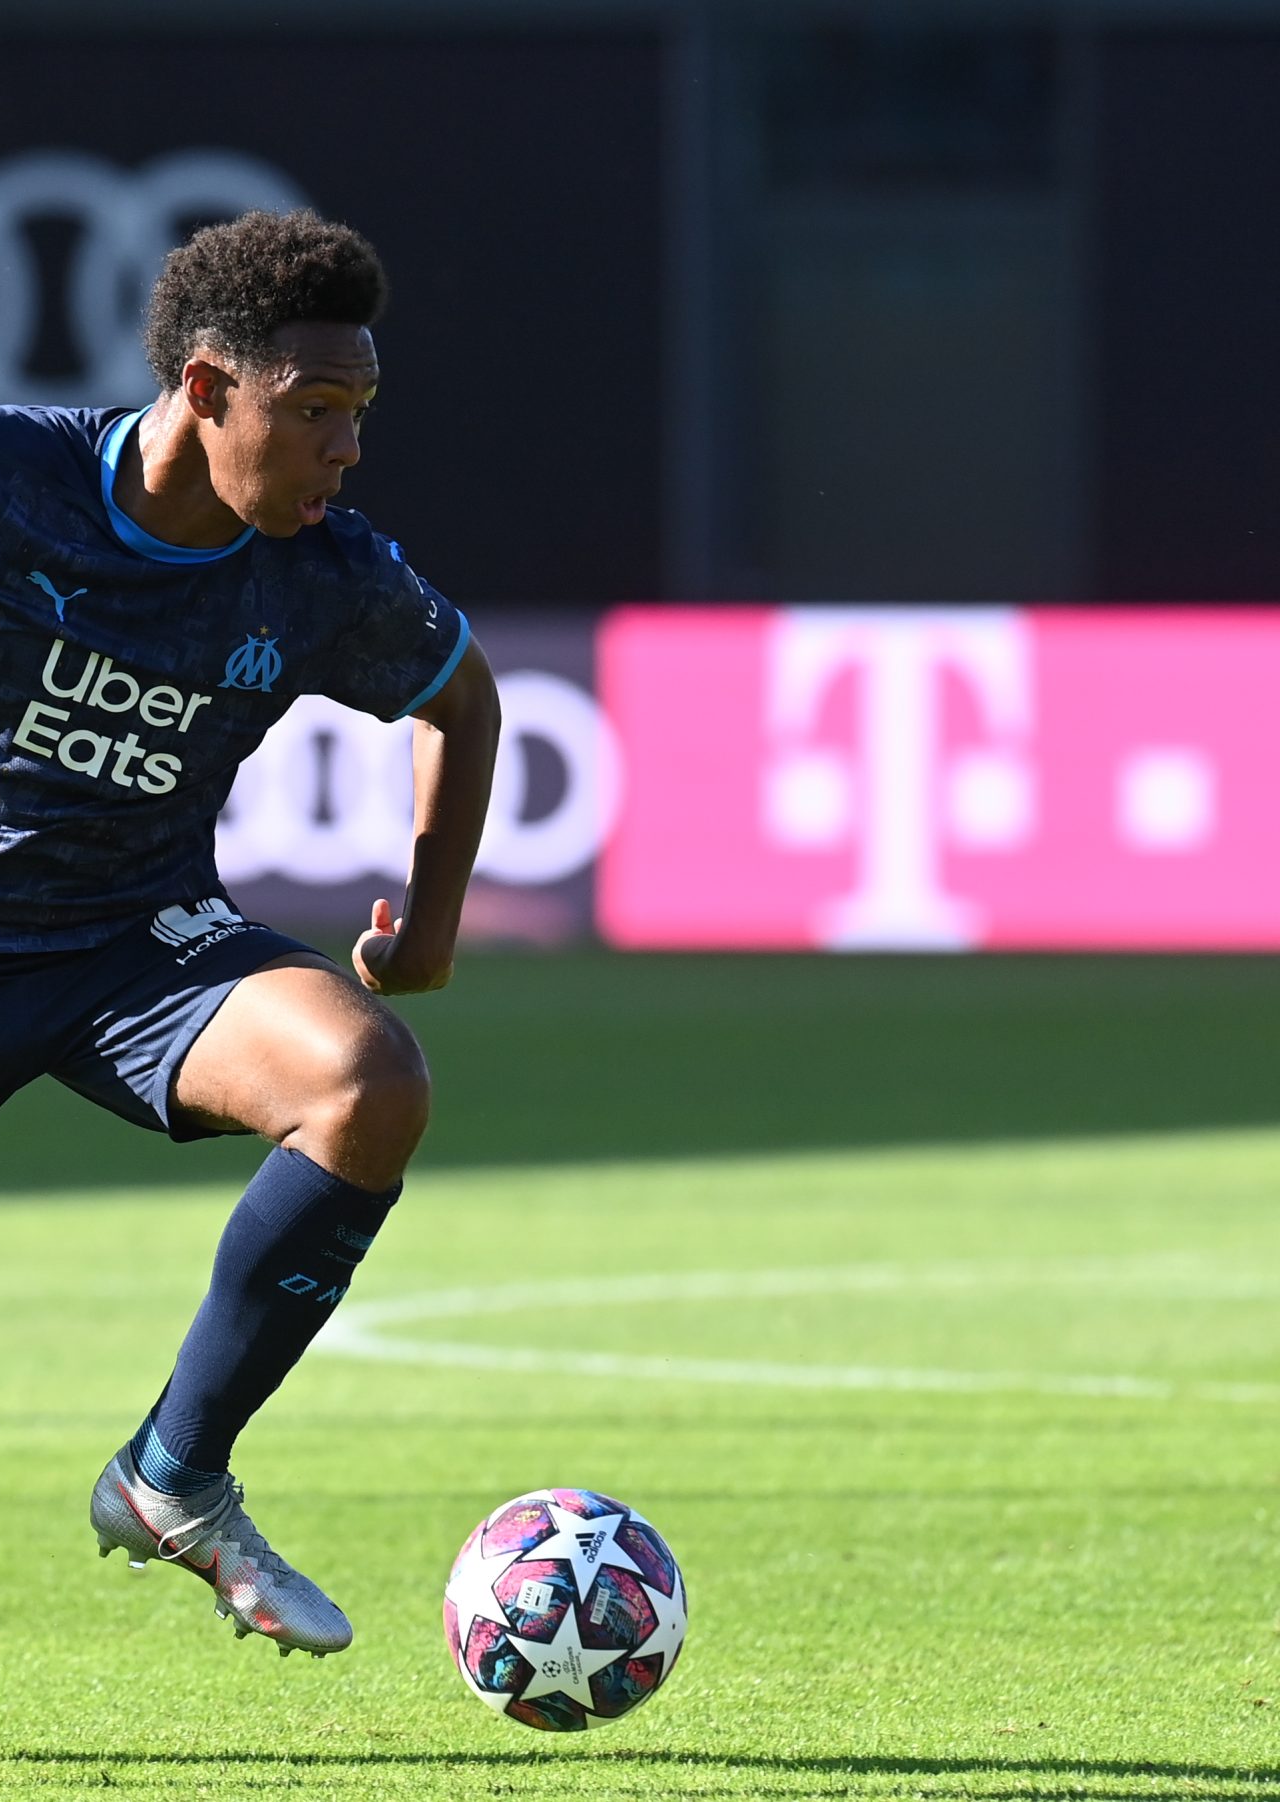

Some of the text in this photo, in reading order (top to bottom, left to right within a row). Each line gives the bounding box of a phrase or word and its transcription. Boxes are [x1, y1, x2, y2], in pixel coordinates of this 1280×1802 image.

[40, 638, 212, 733] Uber
[11, 699, 183, 795] Eats
[586, 1530, 608, 1564] adidas
